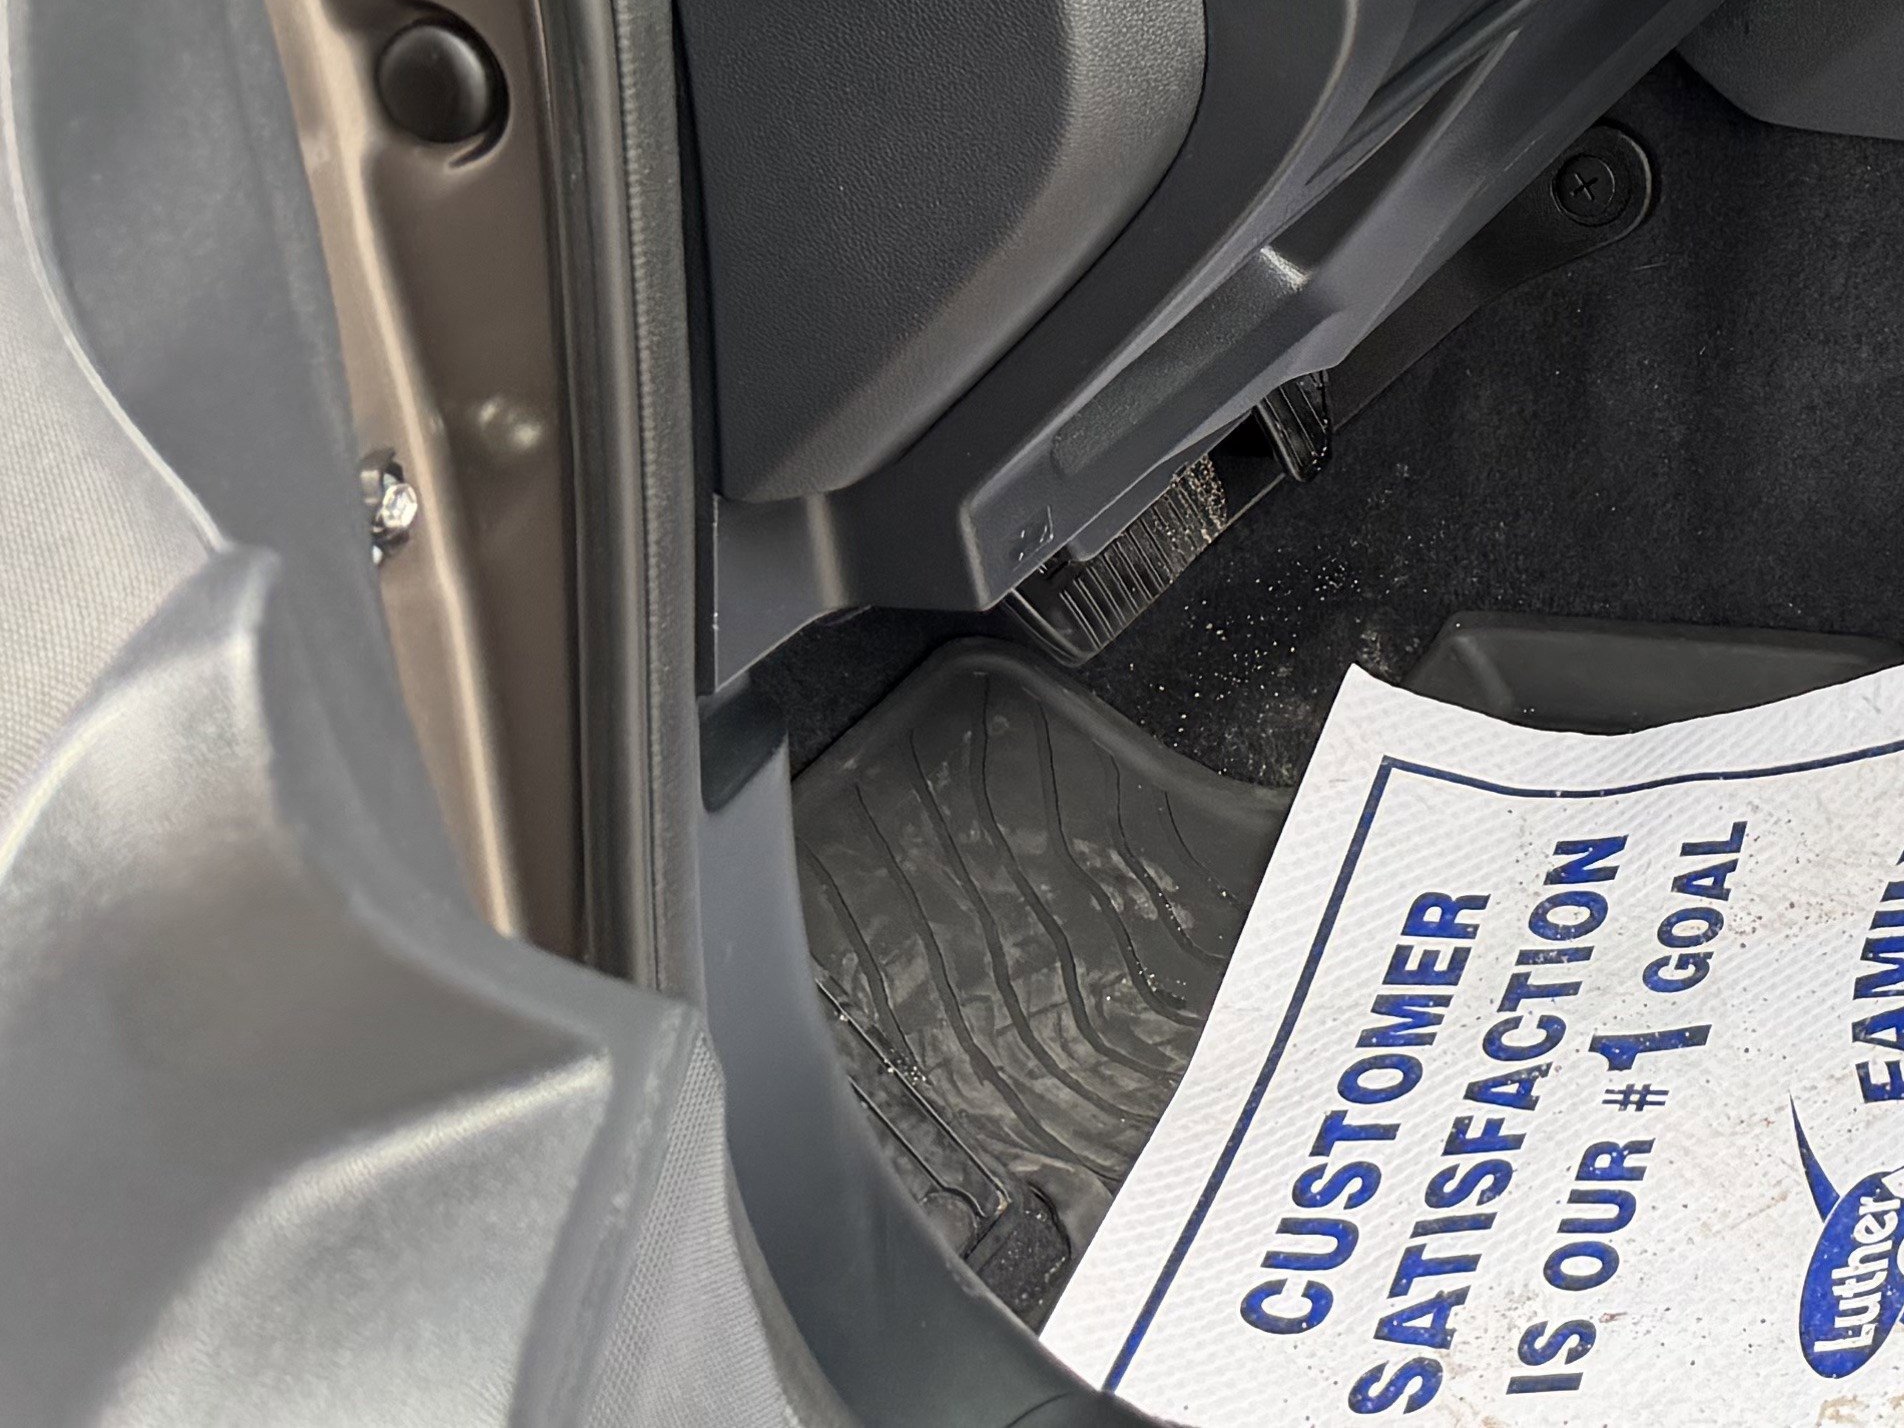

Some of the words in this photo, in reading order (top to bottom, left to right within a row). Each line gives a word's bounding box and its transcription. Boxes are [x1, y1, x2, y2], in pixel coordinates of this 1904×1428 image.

[1641, 819, 1749, 993] GOAL
[1240, 890, 1492, 1335] CUSTOMER
[1347, 834, 1629, 1415] SATISFACTION
[1588, 1024, 1713, 1112] #1
[1542, 1136, 1656, 1292] OUR
[1813, 1195, 1901, 1353] Luther
[1505, 1319, 1598, 1396] IS
